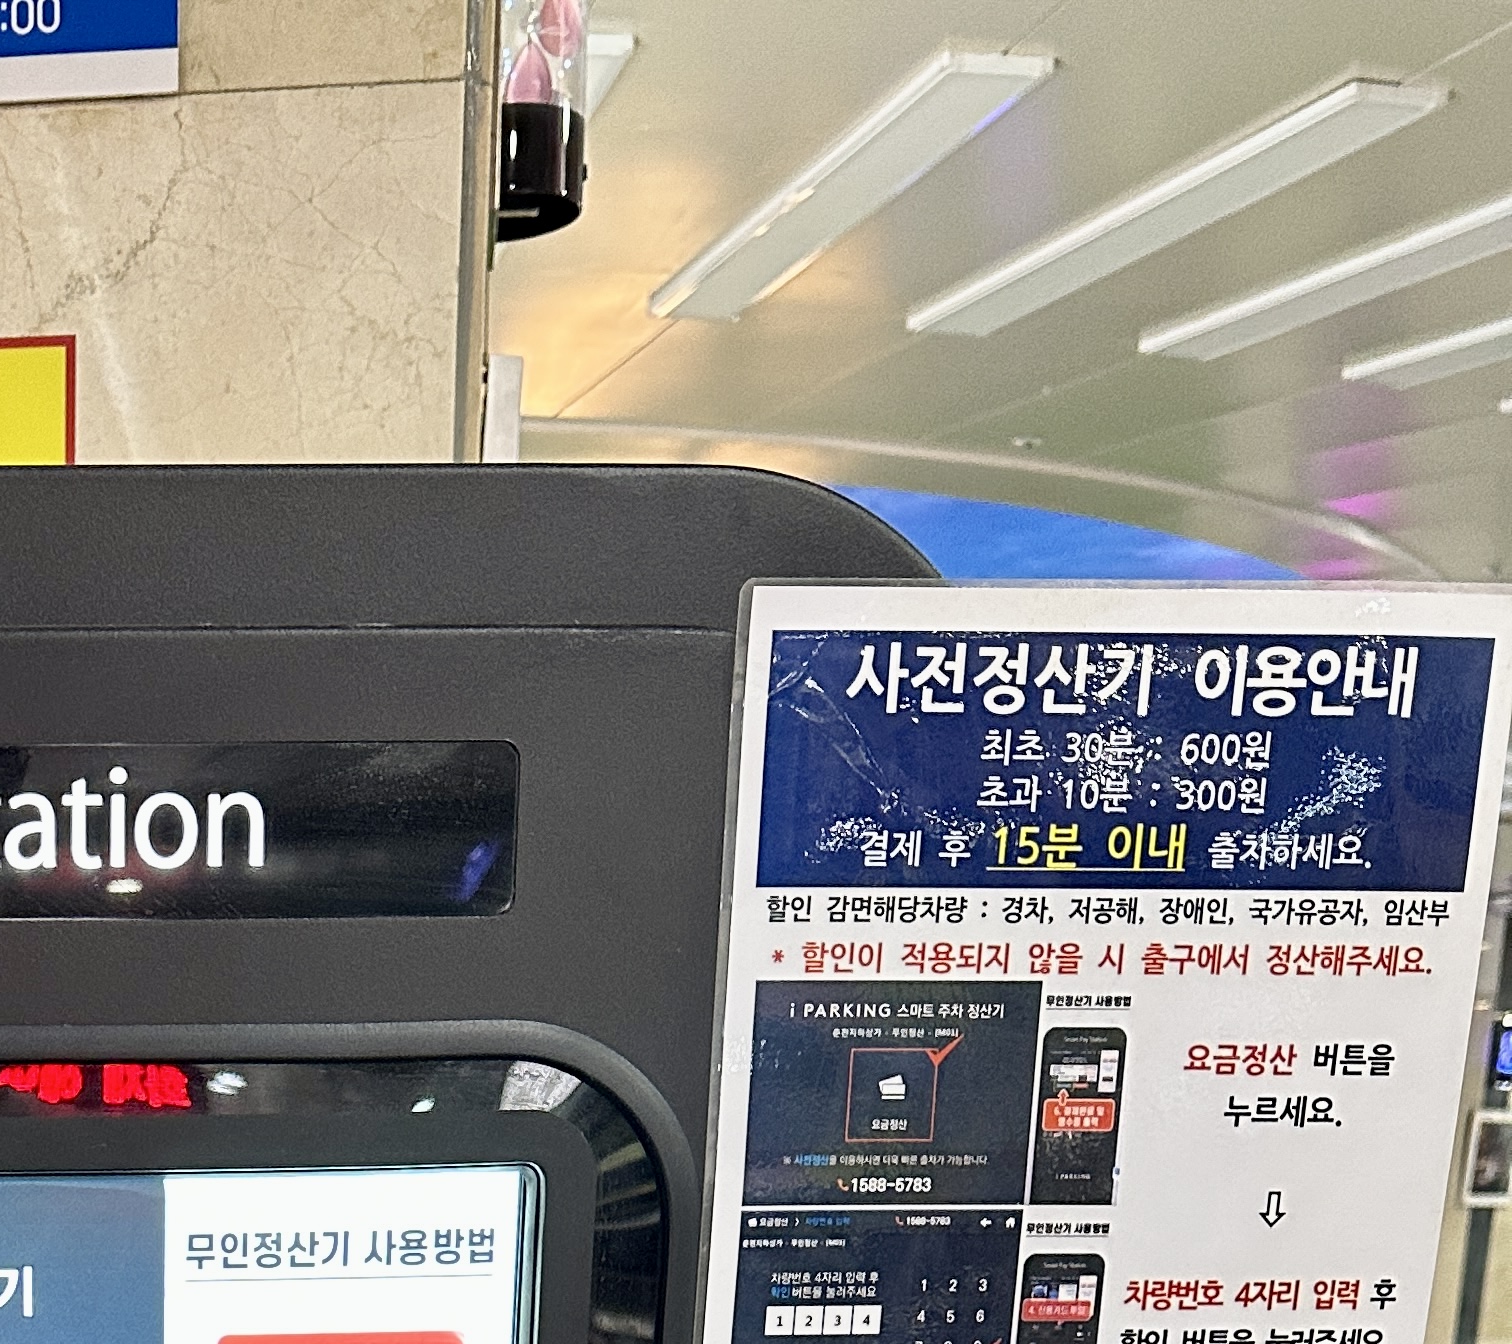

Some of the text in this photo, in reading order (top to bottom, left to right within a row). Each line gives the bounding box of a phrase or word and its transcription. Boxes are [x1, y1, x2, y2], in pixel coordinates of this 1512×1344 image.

[846, 640, 1419, 718] 사전정산기 이용안내
[981, 730, 1272, 769] 최초 30분 600원
[977, 776, 1267, 816] 초과 10분 300원
[860, 823, 1372, 873] 결제 후 15분 이내 출차하세요.
[766, 894, 1451, 928] 할인 감면해당차량 경차, 저공해, 장애인, 국가유공자, 임산부
[801, 941, 1433, 977] 할인이 적용되지 않을 시 출구에서 정산해주세요.
[803, 1003, 1006, 1019] PARKING 스마트 주차 정산기
[1183, 1043, 1396, 1077] 요금정산 버튼을
[1223, 1095, 1343, 1128] 누르세요.
[185, 1228, 495, 1270] 무인정산기 사용방법
[1123, 1279, 1397, 1312] 차량번호 4자리 입력 후
